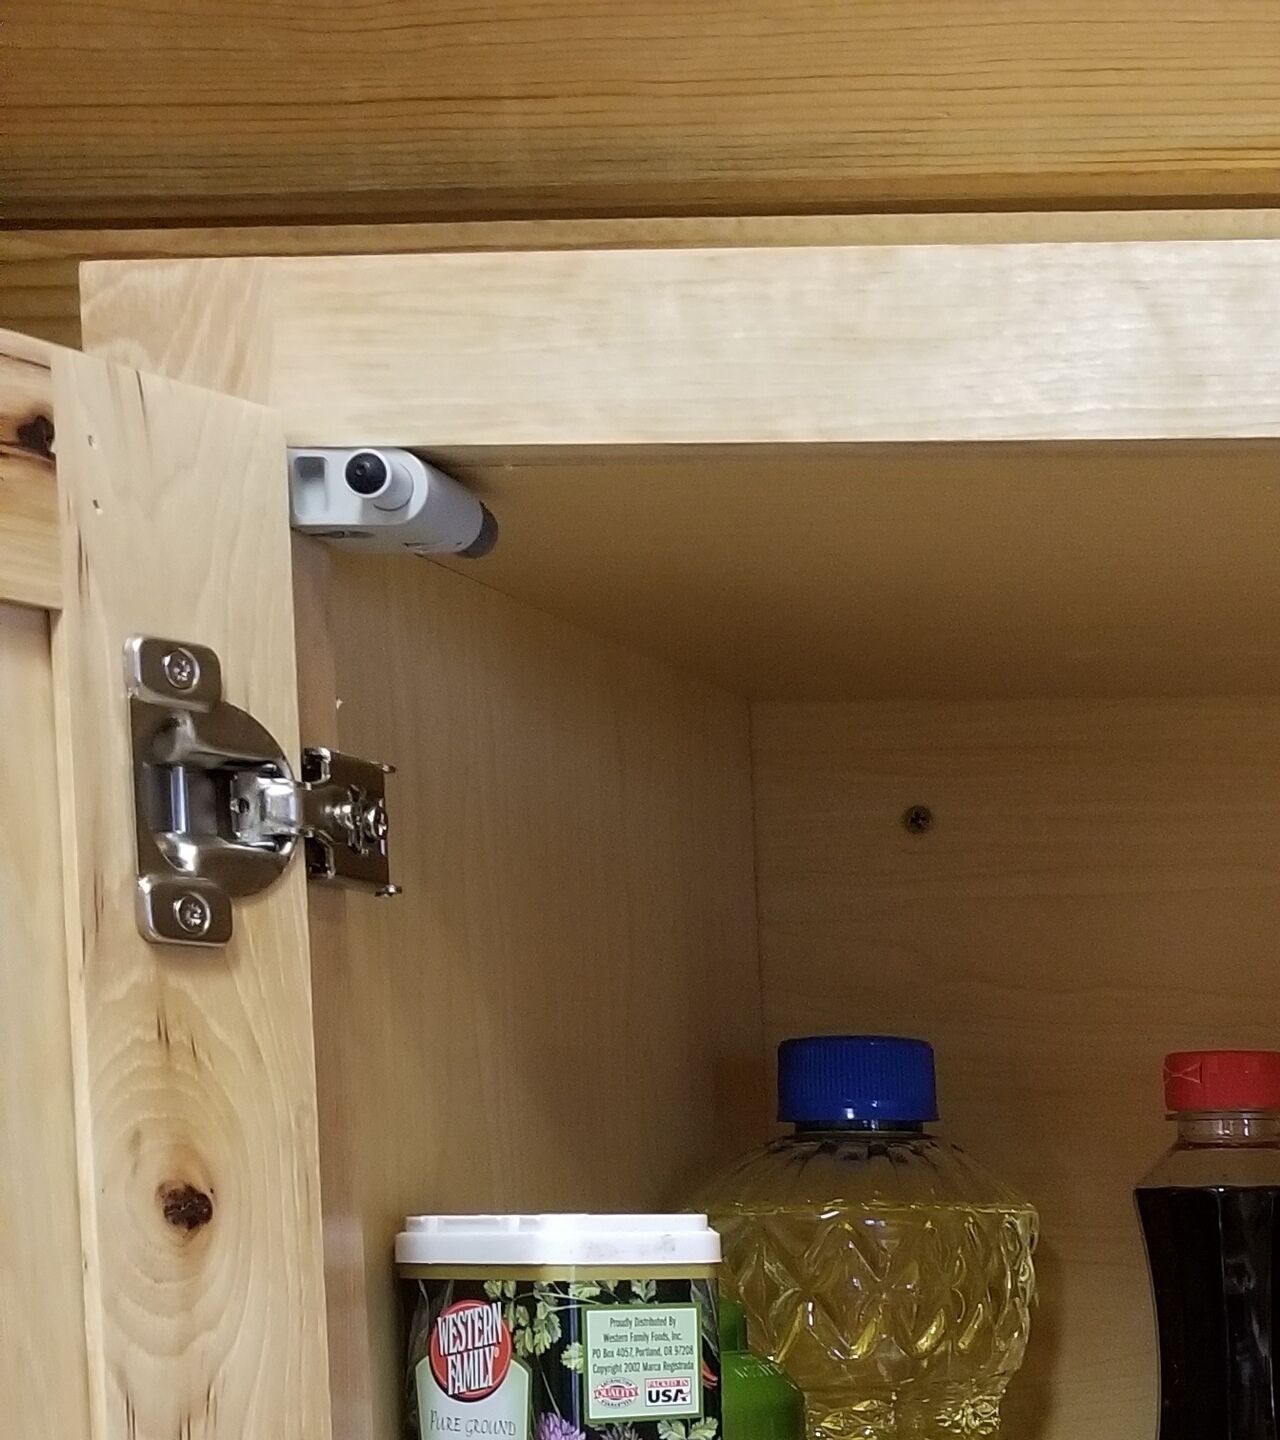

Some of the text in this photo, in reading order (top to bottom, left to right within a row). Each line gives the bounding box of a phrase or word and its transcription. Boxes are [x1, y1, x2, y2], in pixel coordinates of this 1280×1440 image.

[635, 1317, 667, 1327] Distributed
[437, 1302, 502, 1356] WESTERN
[630, 1332, 649, 1343] Family
[603, 1349, 614, 1358] Box
[448, 1346, 494, 1395] FAMILY
[648, 1389, 687, 1403] USA
